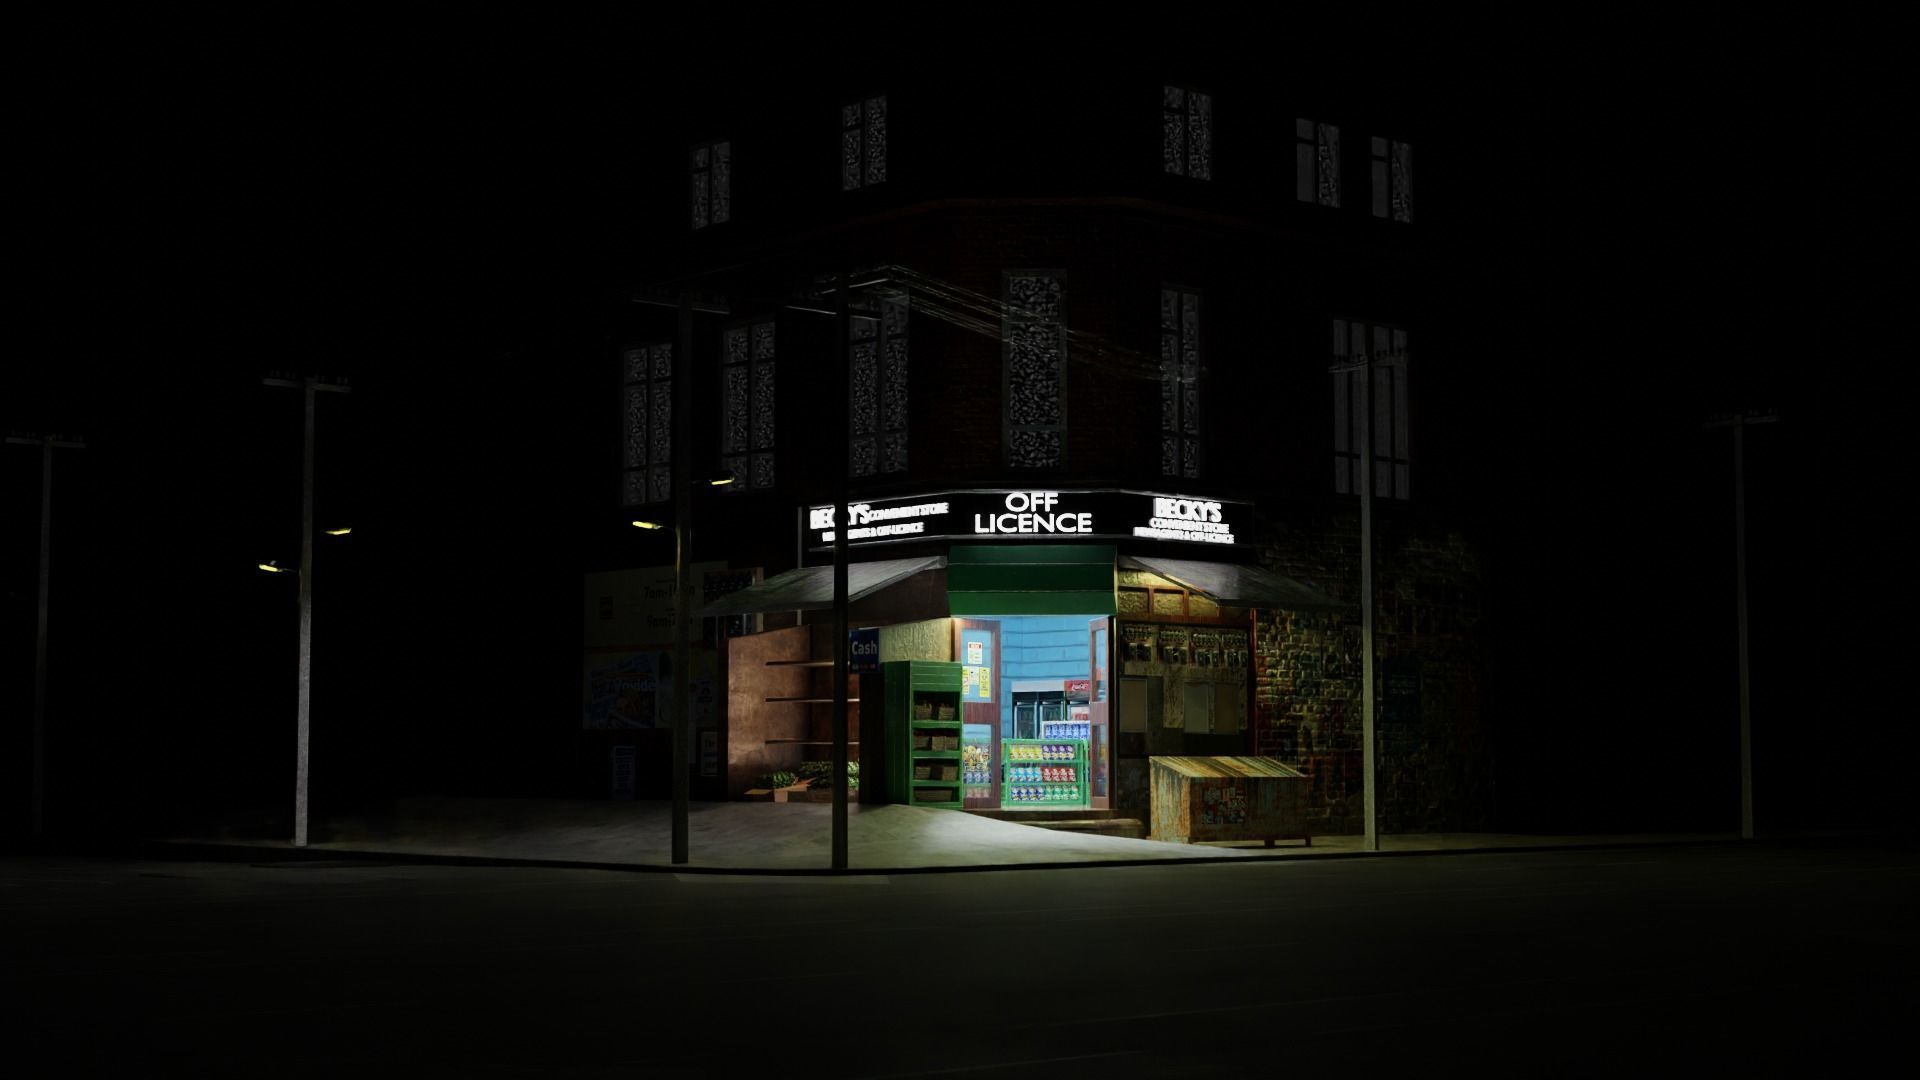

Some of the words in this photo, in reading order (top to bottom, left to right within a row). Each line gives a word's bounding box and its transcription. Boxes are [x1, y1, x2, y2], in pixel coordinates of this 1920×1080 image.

[1005, 492, 1058, 512] OFF
[975, 513, 1093, 533] LICENCE
[851, 639, 878, 656] Cash
